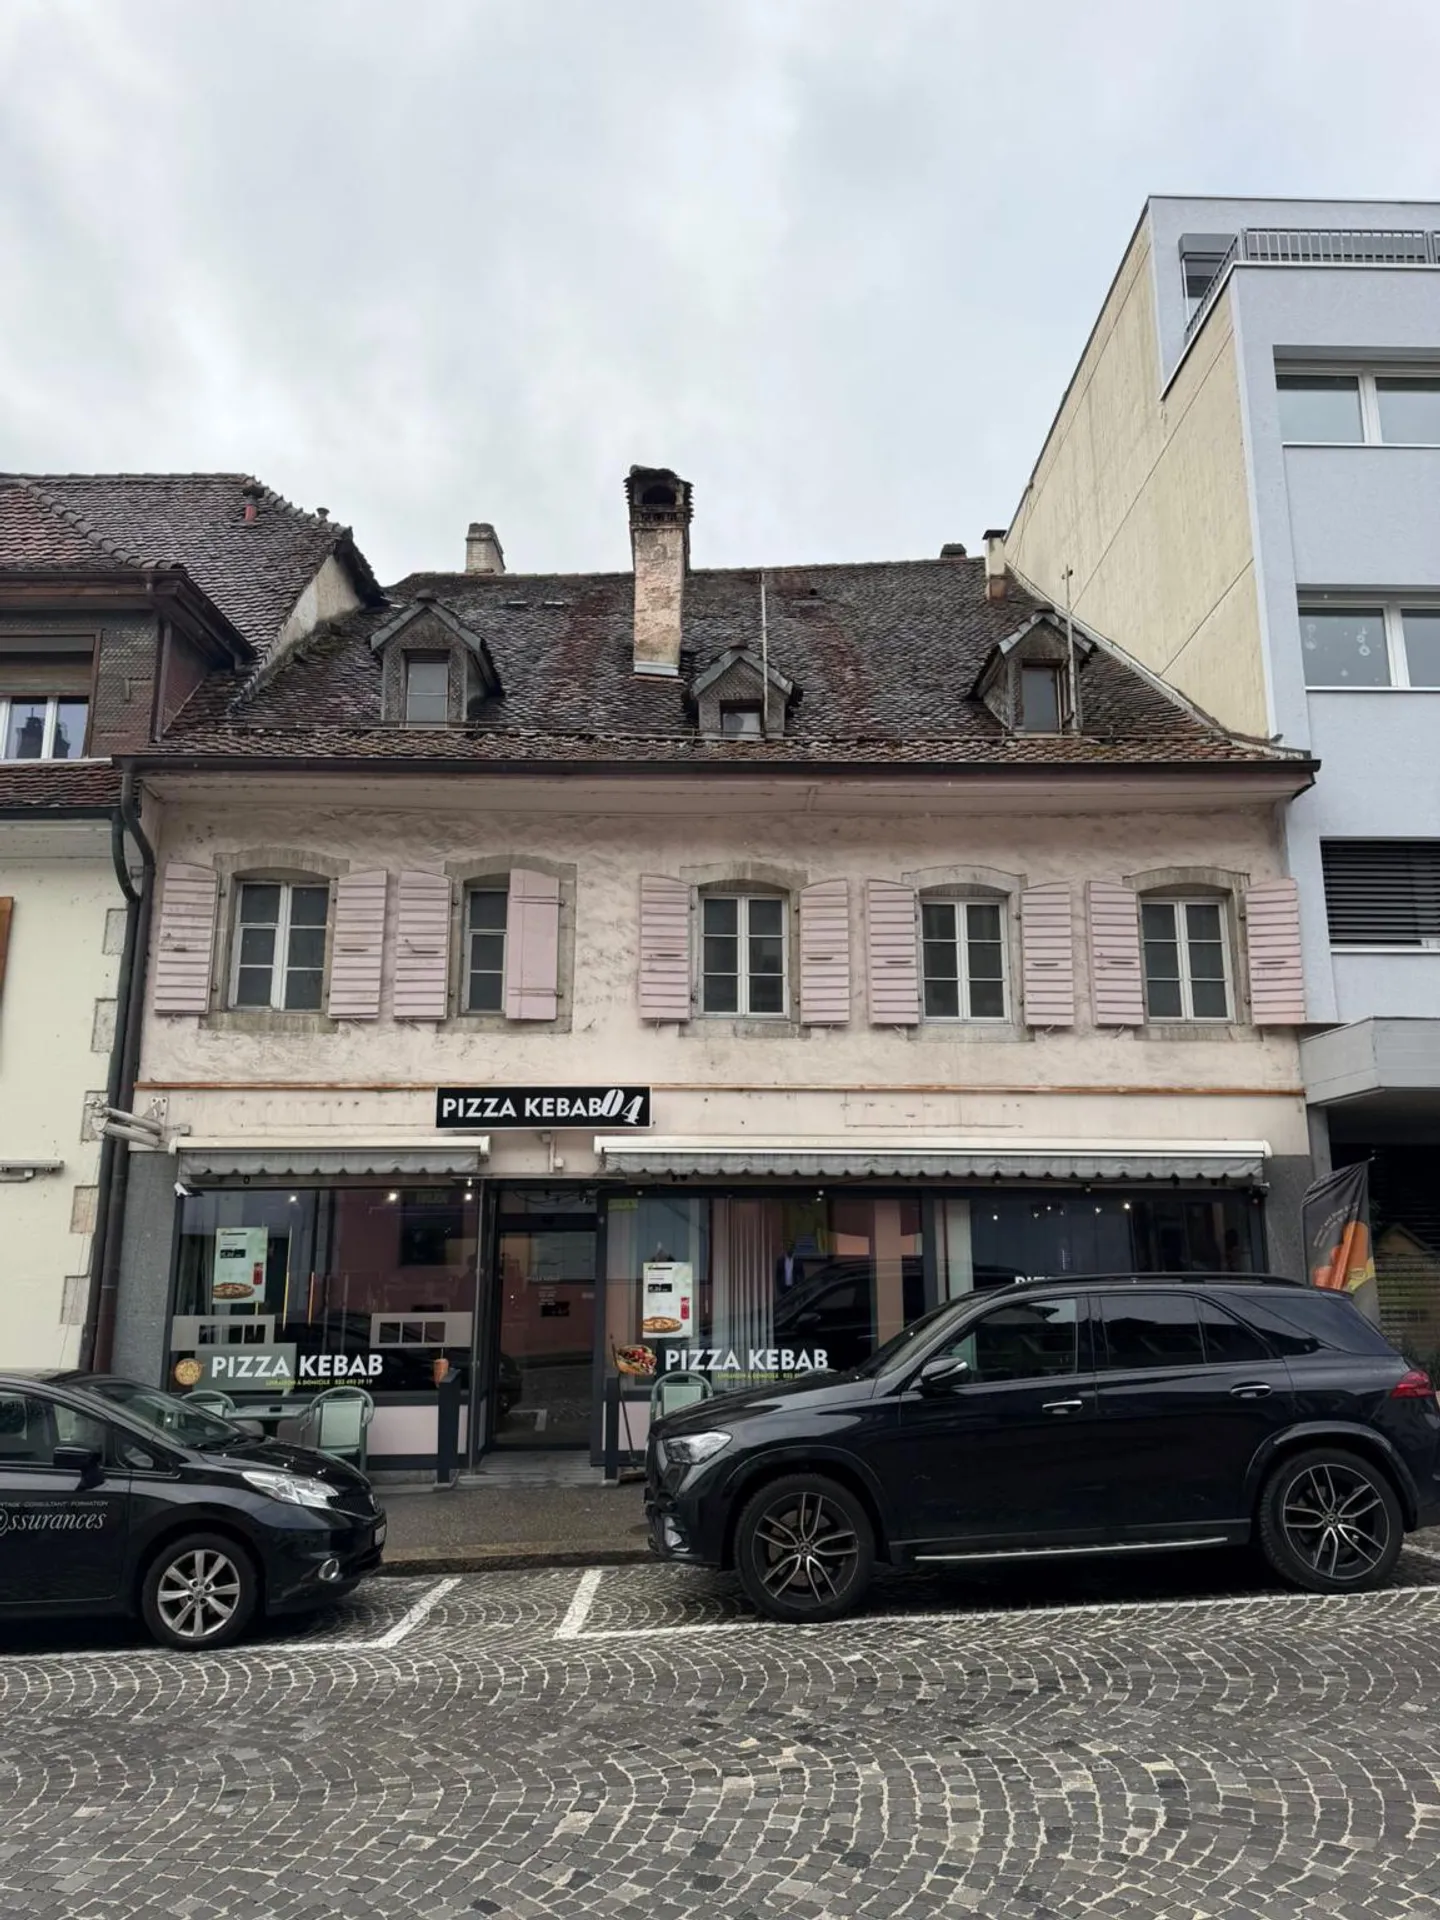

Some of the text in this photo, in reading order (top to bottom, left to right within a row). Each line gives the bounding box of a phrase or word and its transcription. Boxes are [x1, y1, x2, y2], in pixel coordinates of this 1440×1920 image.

[442, 1098, 517, 1118] PIZZA
[211, 1354, 383, 1378] PIZZA KEBAB
[665, 1349, 829, 1371] PIZZA KEBAB
